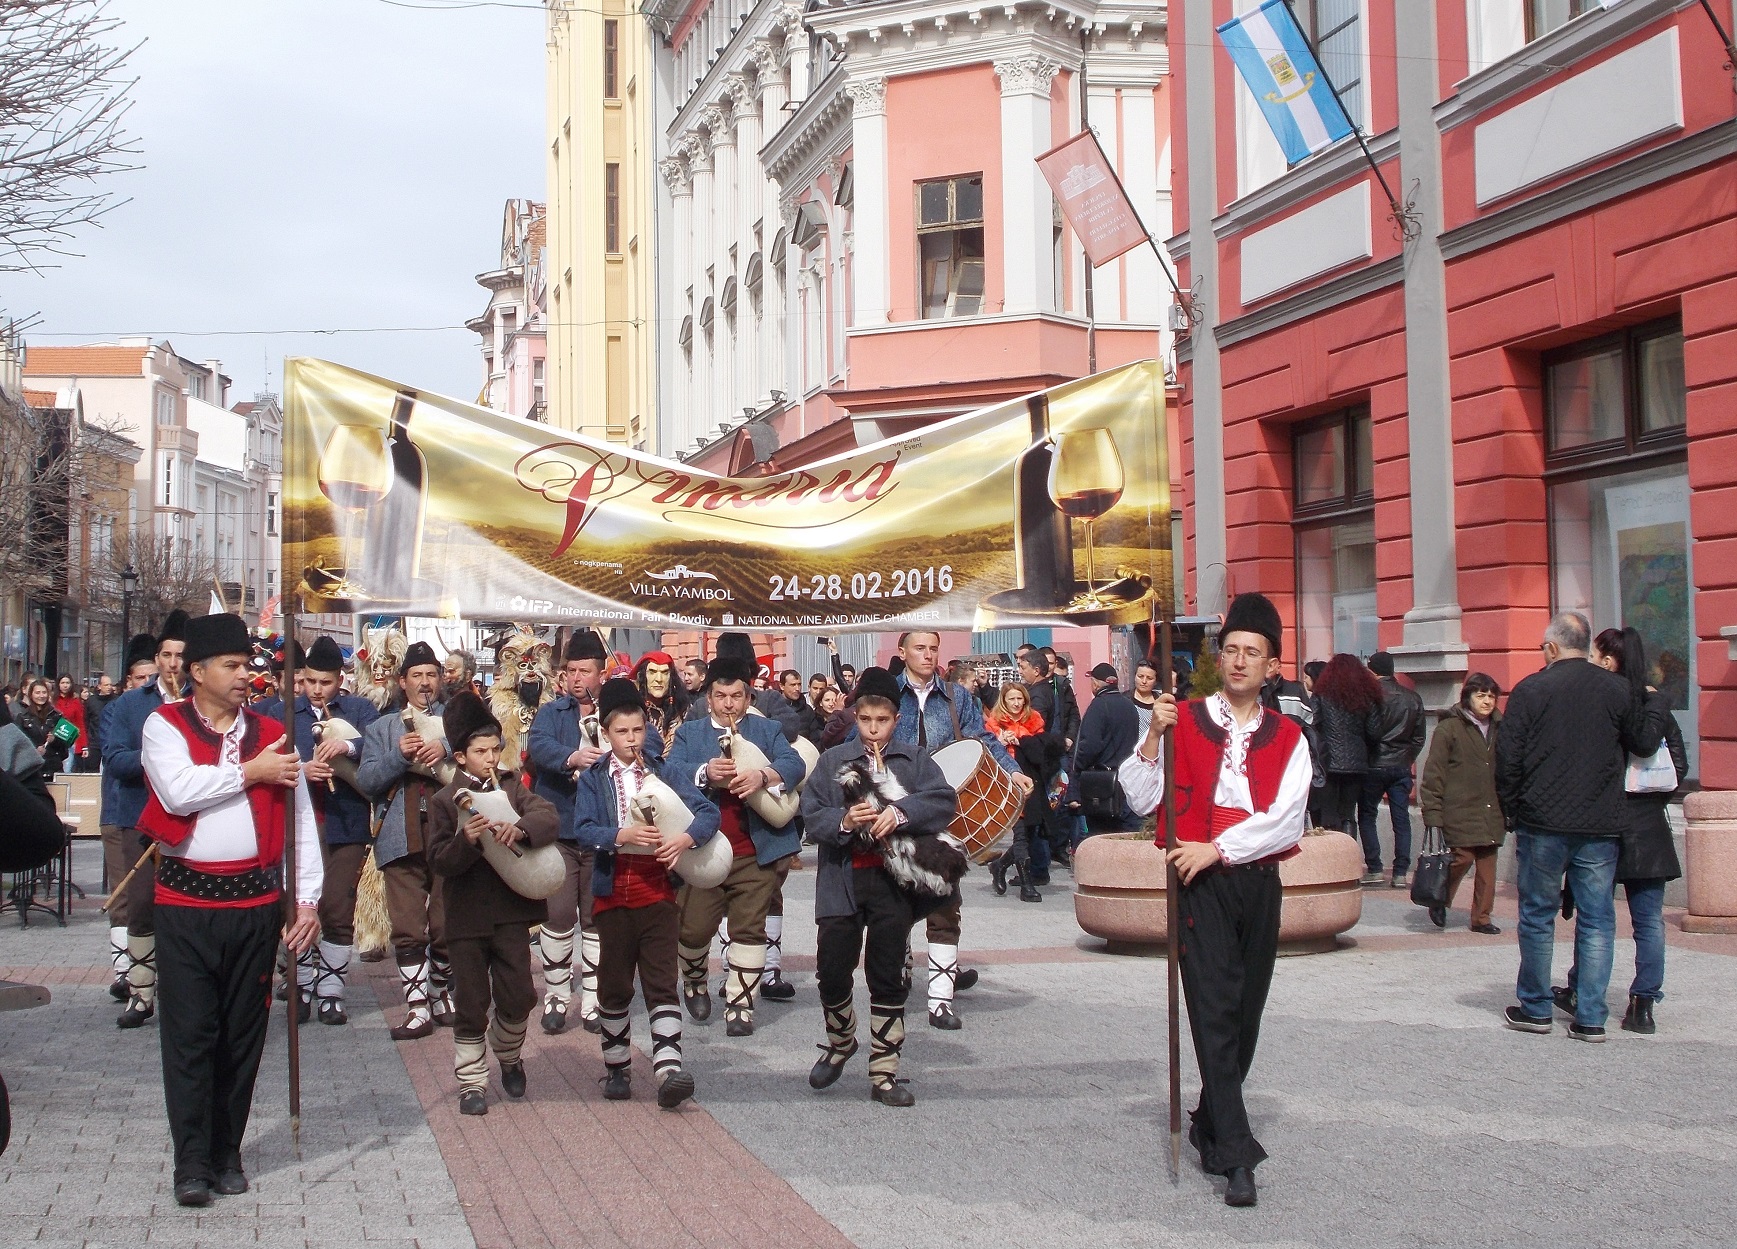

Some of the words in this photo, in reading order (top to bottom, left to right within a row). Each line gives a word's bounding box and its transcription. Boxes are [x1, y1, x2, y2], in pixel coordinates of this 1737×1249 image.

[903, 442, 923, 451] Event
[629, 582, 671, 597] VILLA
[671, 585, 735, 601] YAMBOL
[768, 565, 954, 601] 24-28.02.2016
[557, 604, 634, 620] International
[641, 612, 663, 622] Fair
[668, 612, 712, 625] Plovdiv
[738, 615, 796, 625] NATIONAL
[796, 615, 822, 625] VINE
[824, 614, 849, 624] AND
[850, 613, 881, 624] WINE
[883, 610, 940, 623] CHAMBER
